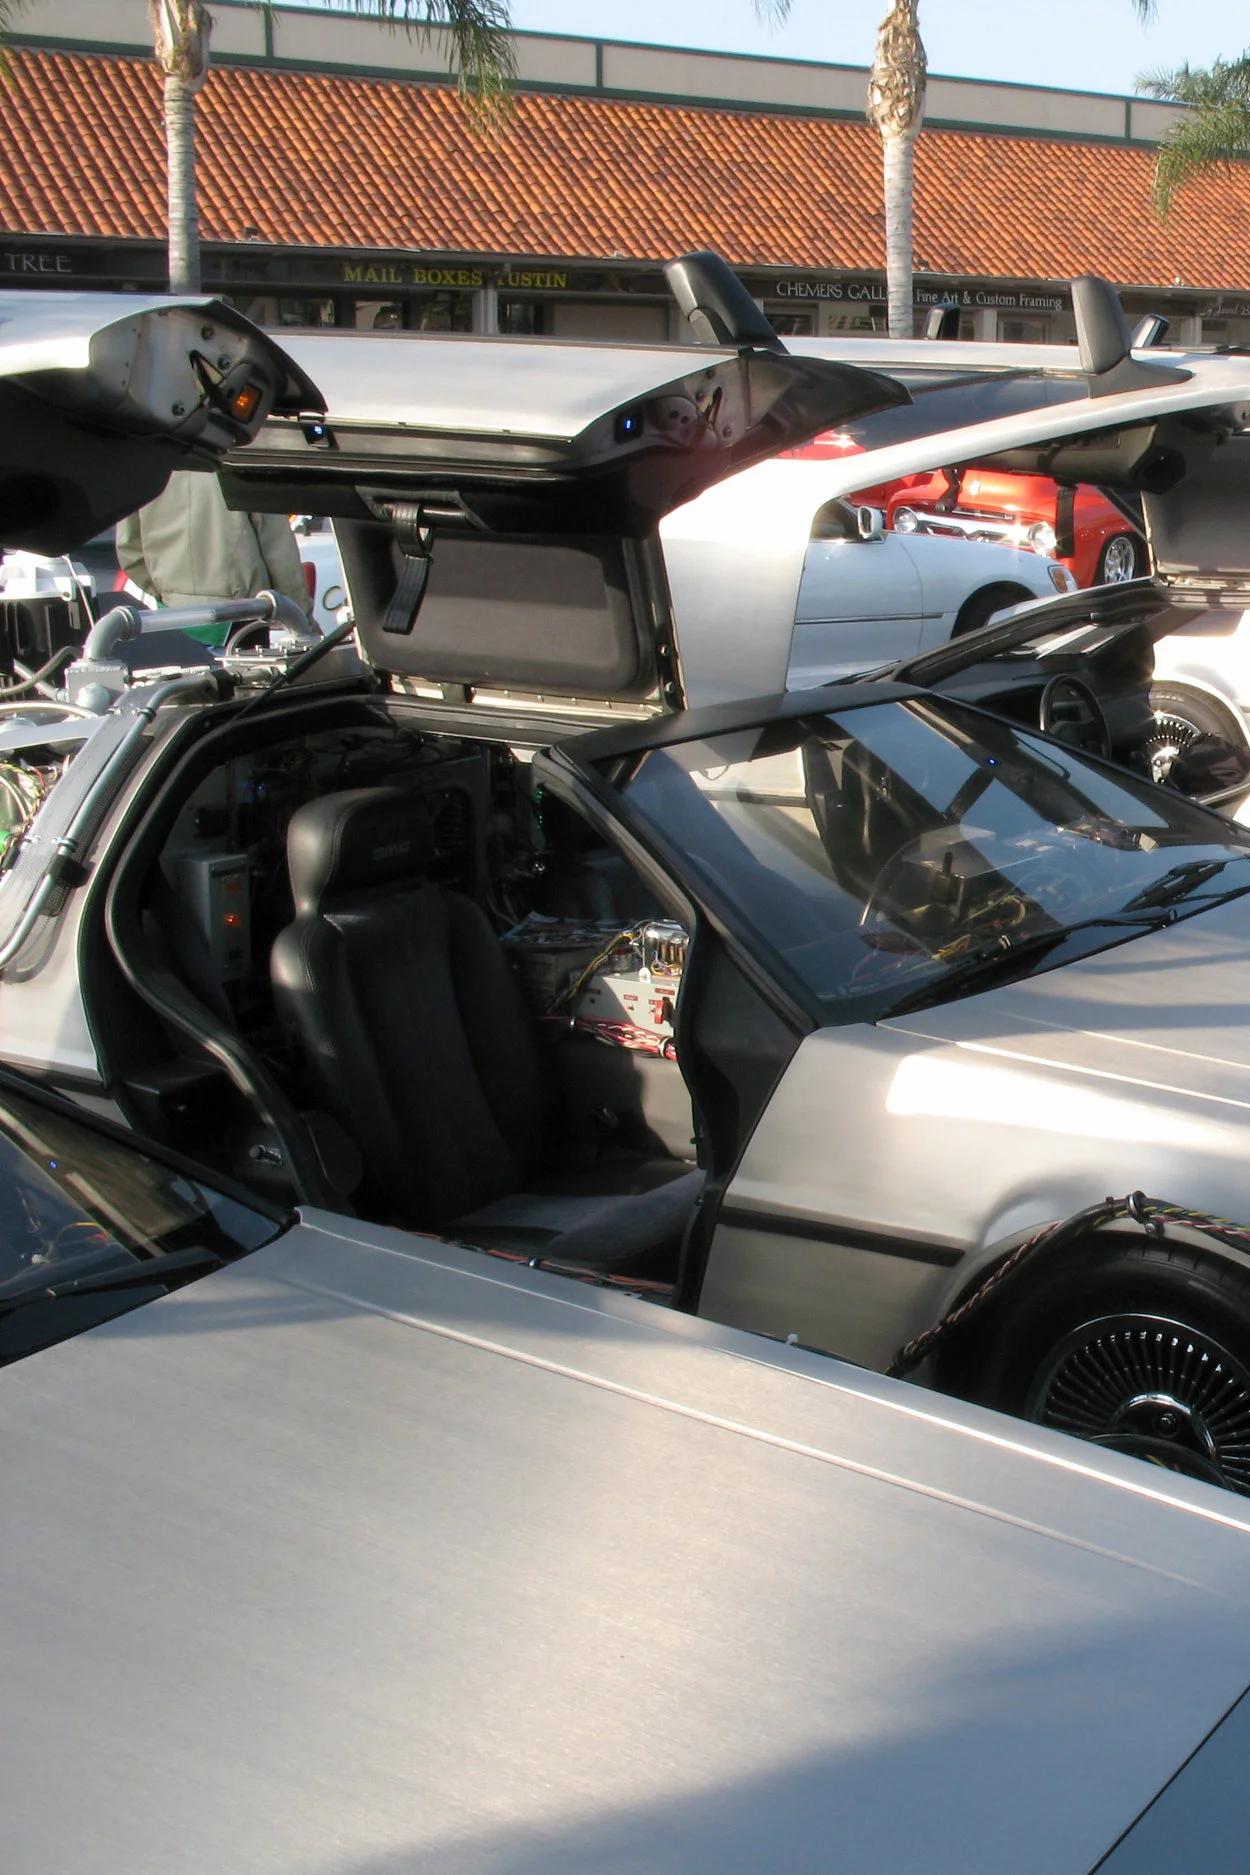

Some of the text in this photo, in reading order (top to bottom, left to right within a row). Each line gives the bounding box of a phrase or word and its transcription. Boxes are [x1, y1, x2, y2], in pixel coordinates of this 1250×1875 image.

[4, 252, 73, 272] TREE
[344, 266, 402, 283] MAIL
[413, 268, 483, 285] BOXES
[776, 281, 842, 299] CHEMERS
[916, 289, 938, 303] Fine
[942, 290, 959, 304] Art
[963, 291, 972, 304] &
[976, 291, 1016, 306] Custom
[1019, 293, 1063, 311] Framing
